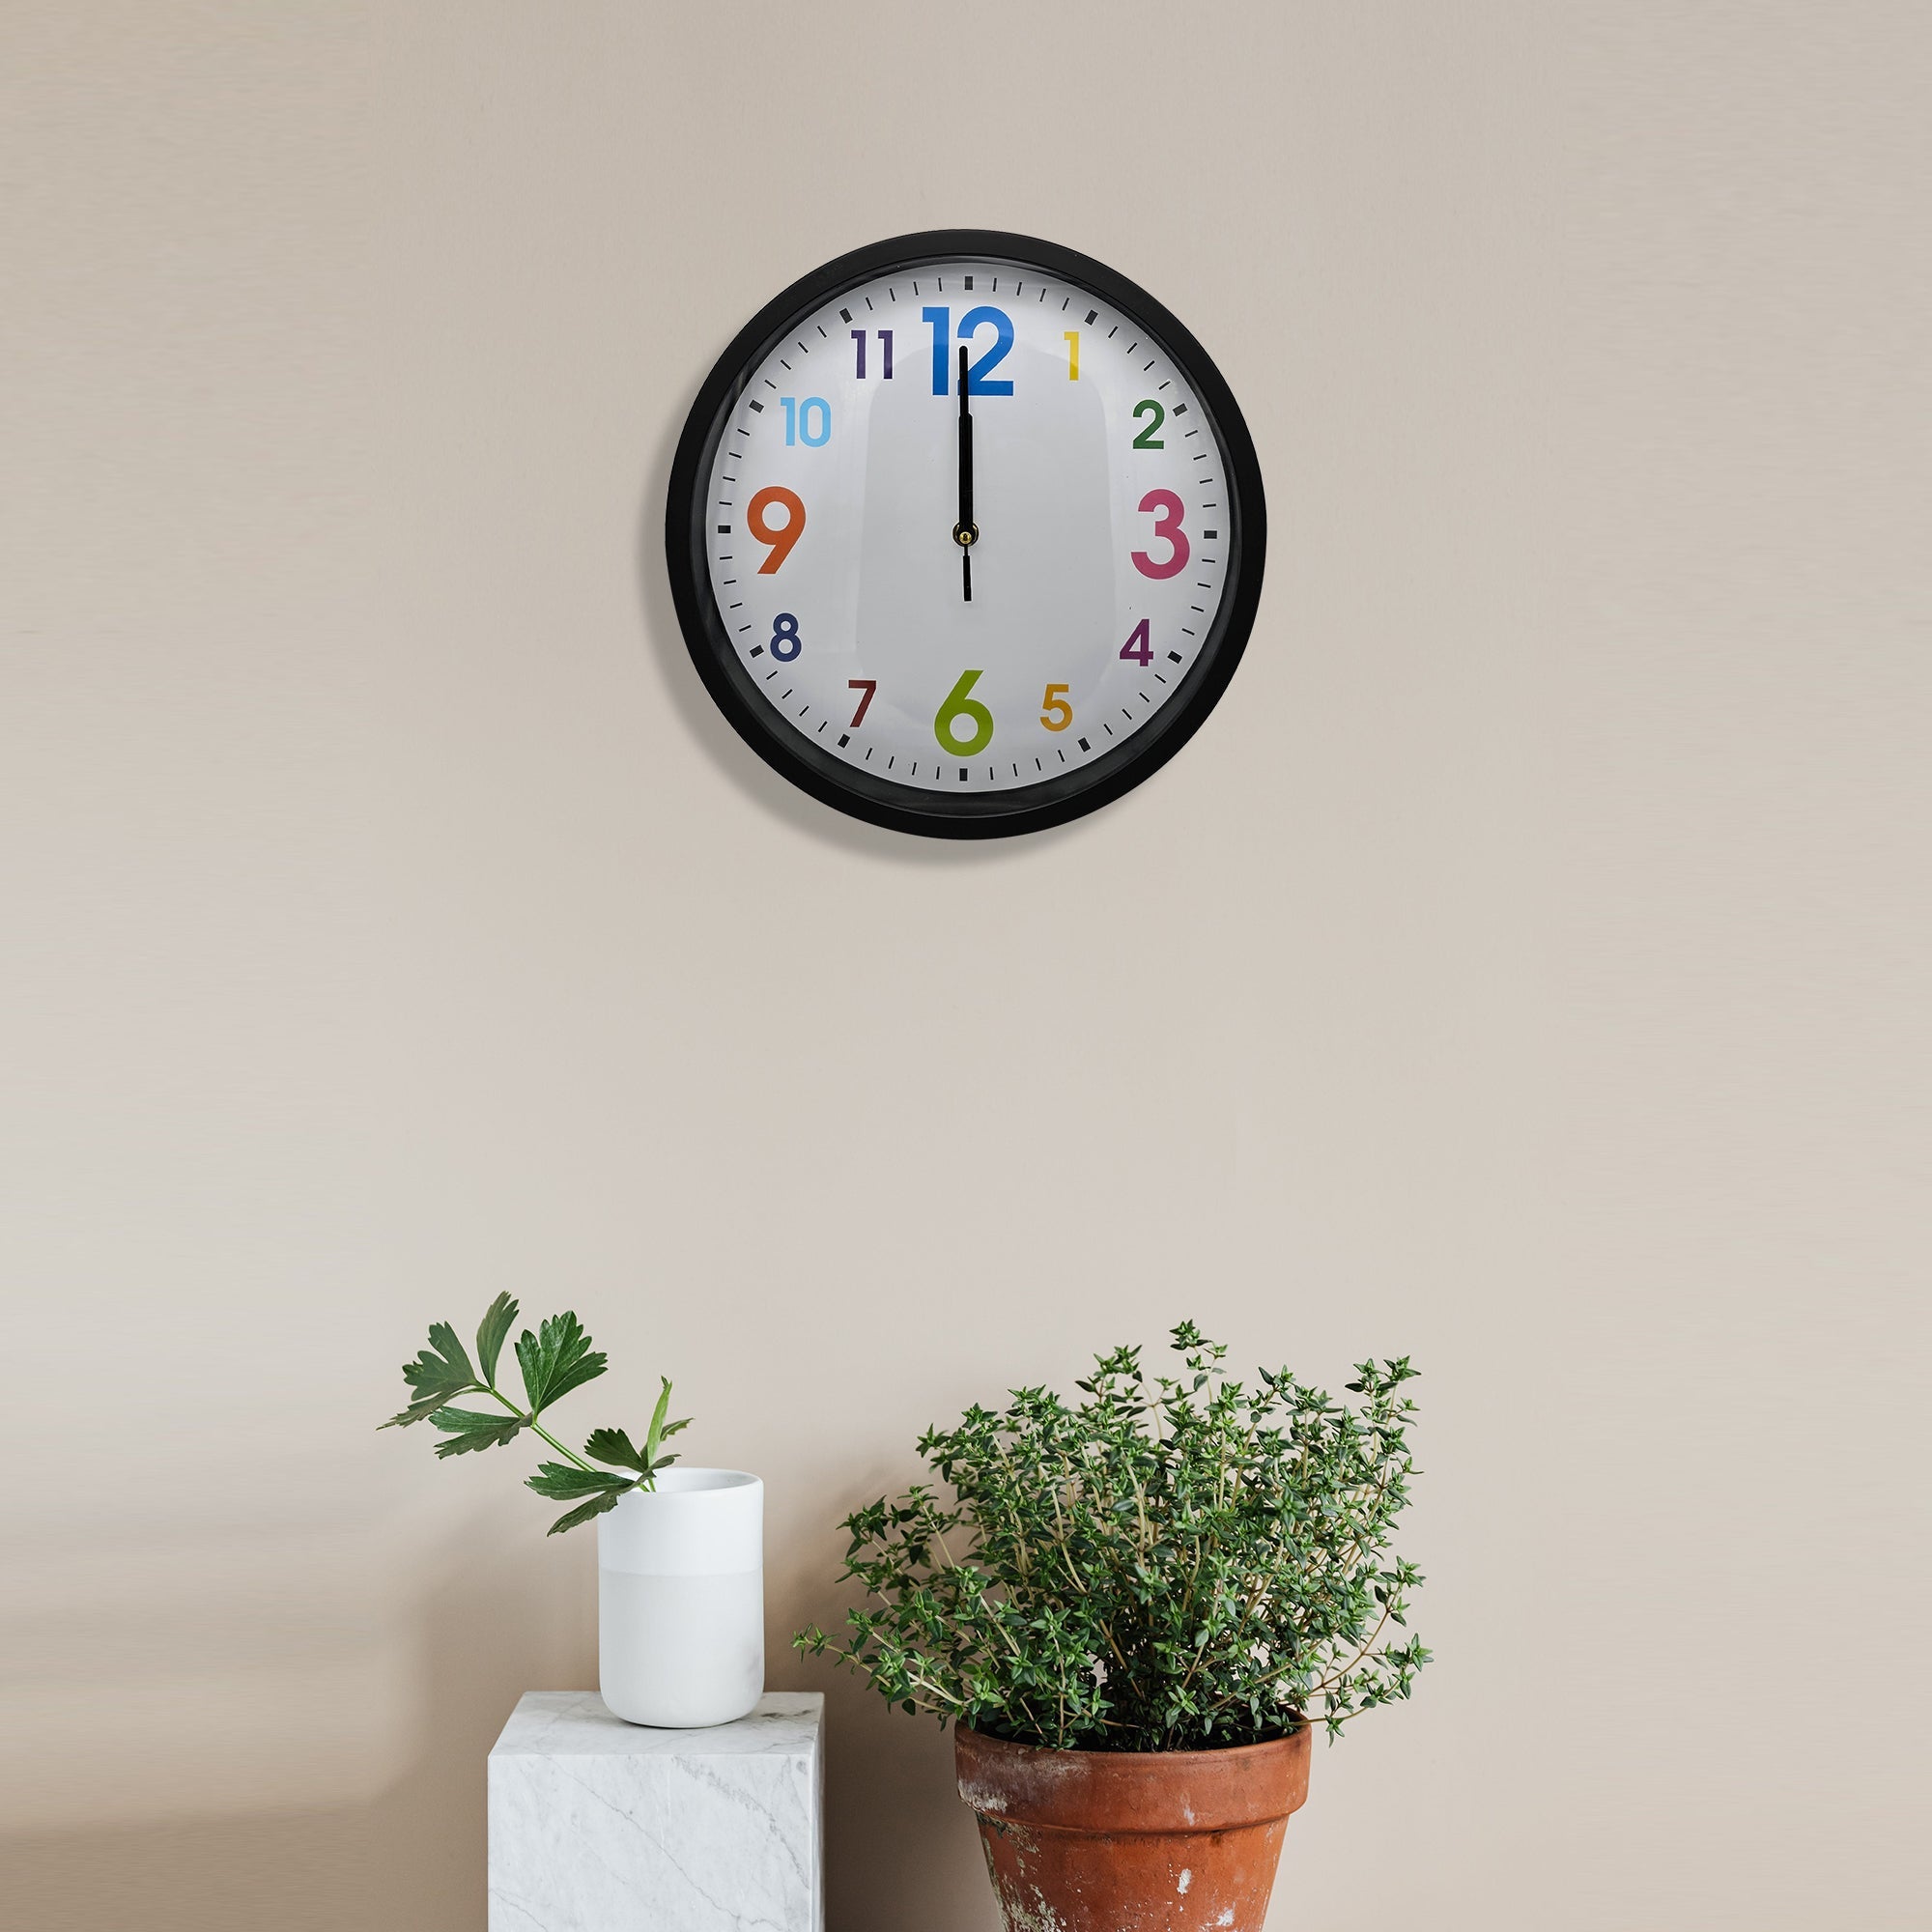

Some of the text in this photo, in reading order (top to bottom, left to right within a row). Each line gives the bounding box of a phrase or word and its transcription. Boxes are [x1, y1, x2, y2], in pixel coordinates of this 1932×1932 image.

[851, 329, 894, 380] 11
[922, 305, 1015, 397] 12
[1064, 330, 1080, 382] 1
[780, 396, 832, 448] 10
[1132, 399, 1165, 450] 2
[747, 486, 807, 575] 9
[1130, 488, 1191, 581] 3
[770, 612, 802, 663] 8
[1119, 618, 1154, 668] 4
[847, 679, 877, 728] 7
[933, 668, 995, 757] 6
[1039, 683, 1073, 733] 5
